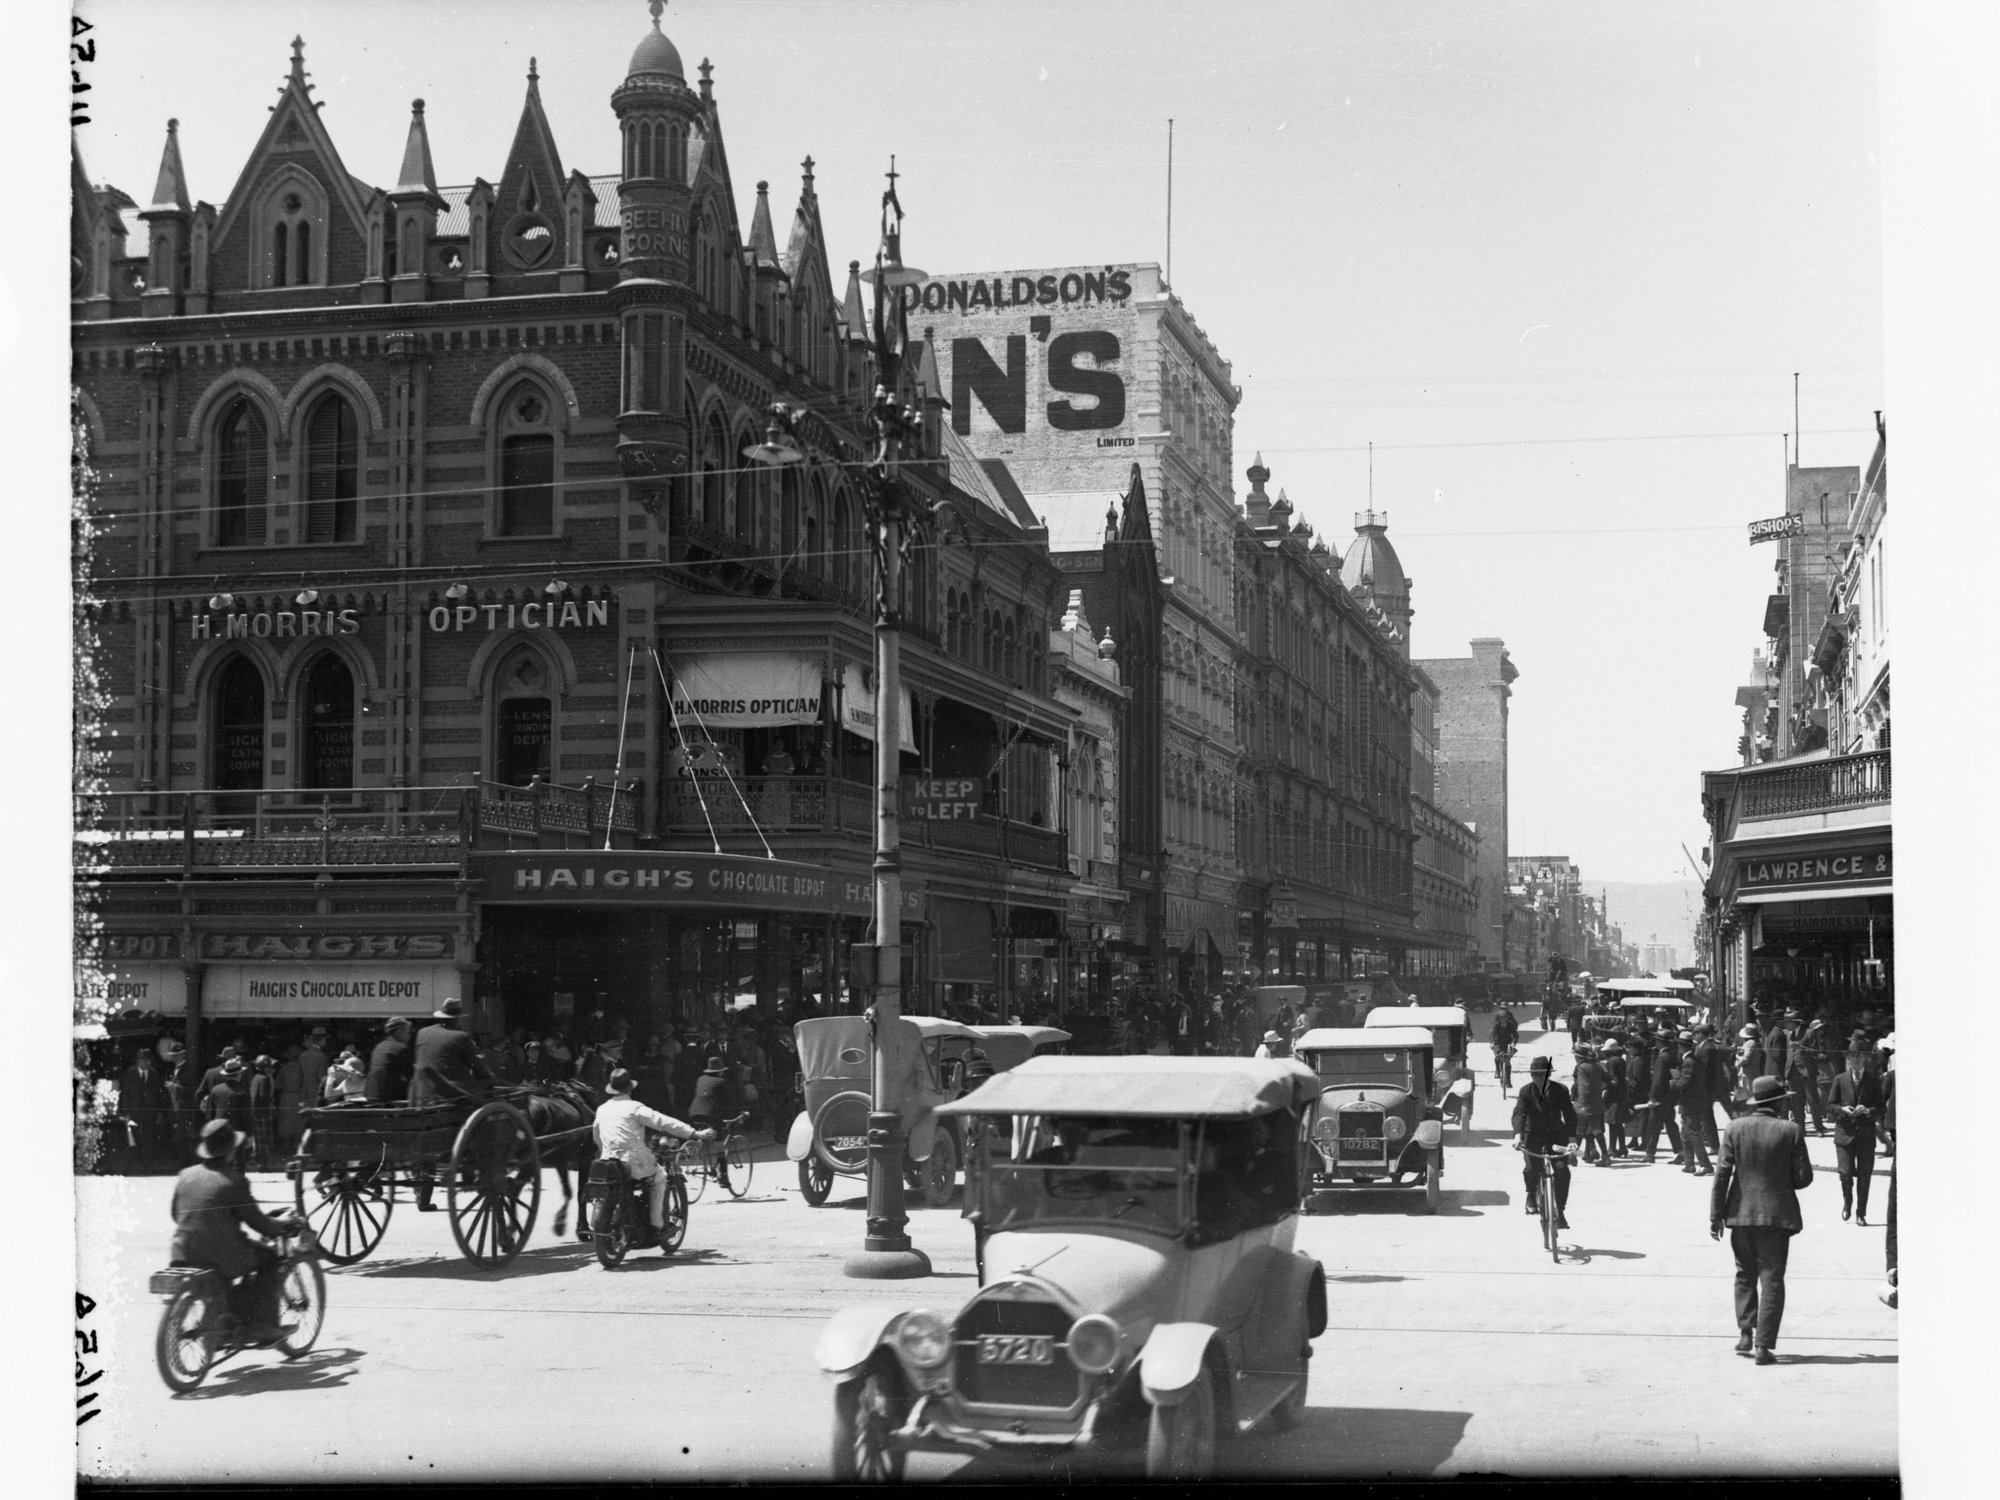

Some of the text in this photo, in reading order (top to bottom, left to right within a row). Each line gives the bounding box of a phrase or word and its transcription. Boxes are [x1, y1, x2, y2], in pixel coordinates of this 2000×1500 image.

[904, 265, 1132, 312] DONALDSON'S
[1096, 437, 1135, 448] LIMITED
[1749, 516, 1802, 537] BISHOP'S
[191, 600, 609, 640] H.MORRIS OPTICIAN
[674, 697, 819, 715] H.MORRIS OPTICIAN
[914, 780, 974, 798] KEEP
[910, 802, 979, 819] TO LEFT
[1747, 854, 1888, 882] LAWRENCE &
[515, 868, 826, 897] HAIGH'S CHOCOLATE DEPOT
[845, 883, 920, 908] HA'S
[206, 935, 447, 957] HAIGH'S
[108, 981, 149, 998] DEPOT
[249, 980, 421, 998] HAIGH'S CHOCOLATE DEPOT
[837, 1136, 863, 1147] 7054
[1344, 1140, 1379, 1149] 10782
